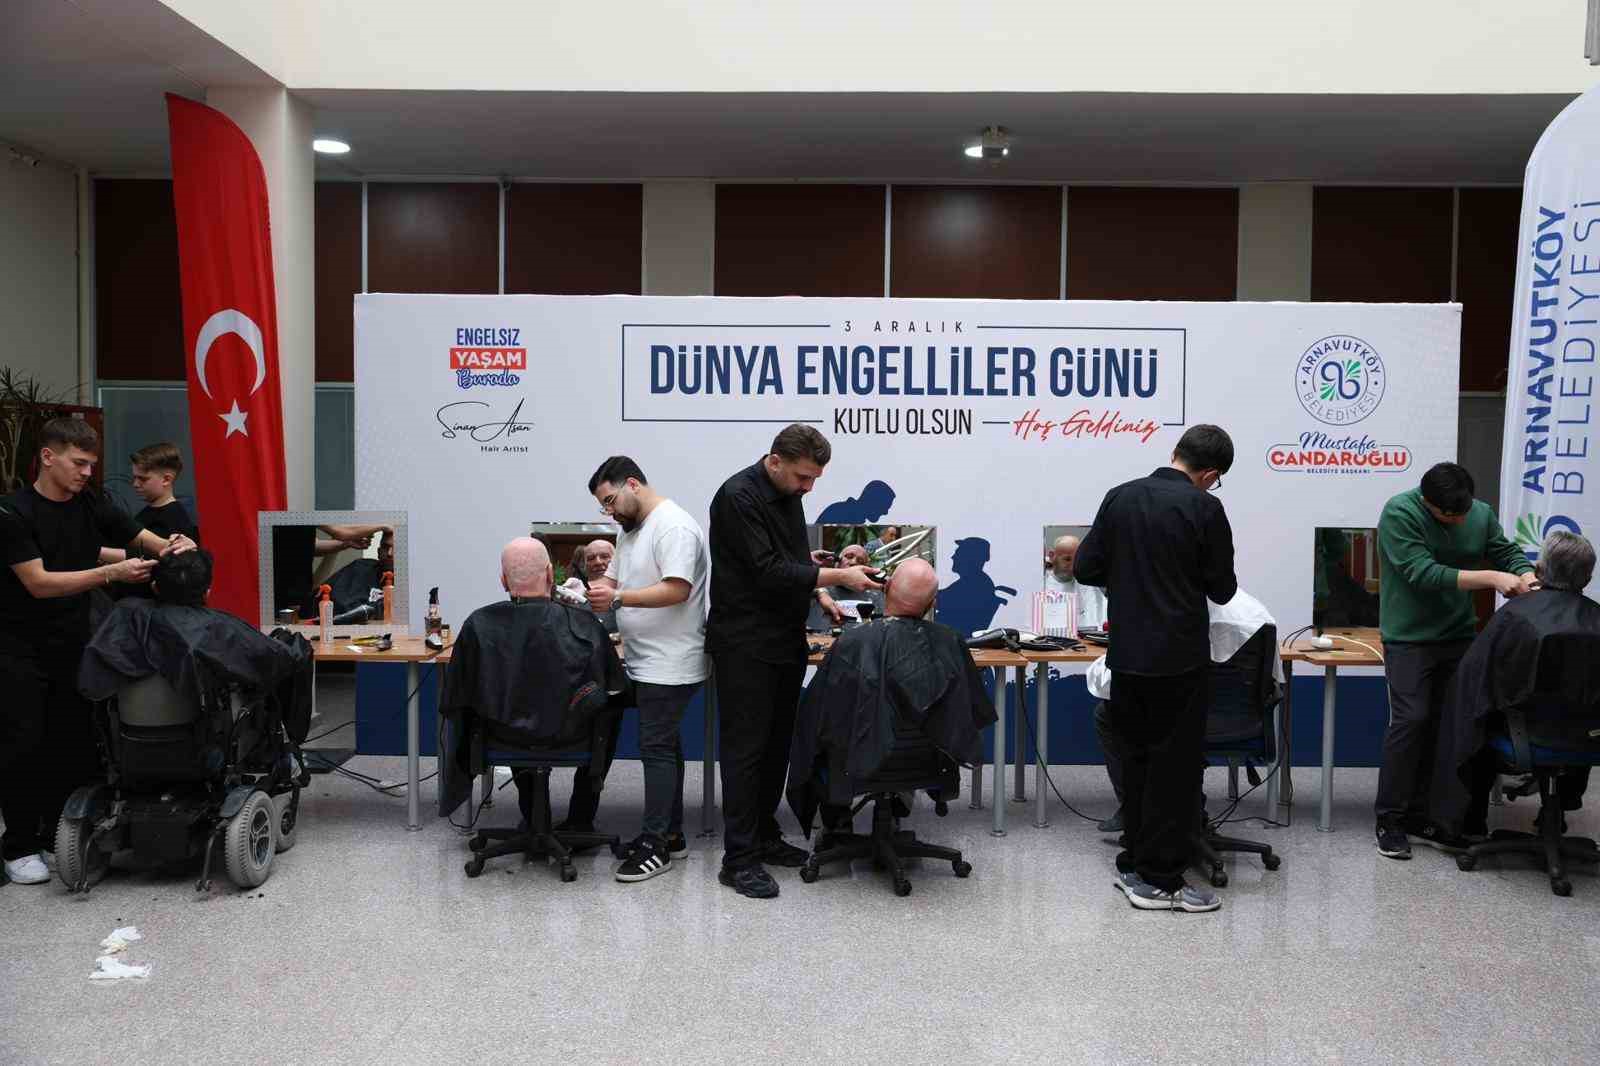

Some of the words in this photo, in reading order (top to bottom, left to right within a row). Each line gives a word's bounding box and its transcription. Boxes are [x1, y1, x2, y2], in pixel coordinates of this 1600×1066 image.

[844, 321, 852, 332] 3
[873, 320, 962, 333] ARALIK
[455, 351, 522, 369] YAŞAM
[1302, 339, 1381, 374] ARNAVUTKÖY
[1522, 206, 1565, 494] ARNAVUTKÖY
[456, 367, 520, 389] Burada
[650, 345, 784, 395] DÜNYA
[1049, 347, 1158, 398] GÜNÜ
[437, 401, 490, 439] Sinan
[834, 408, 899, 434] KUTLU
[906, 408, 972, 435] OLSUN
[1013, 409, 1057, 441] Hoş
[1060, 409, 1160, 443] Geldiniz
[1300, 431, 1376, 456] Mustafa
[1271, 451, 1406, 466] CANDAROĞLU
